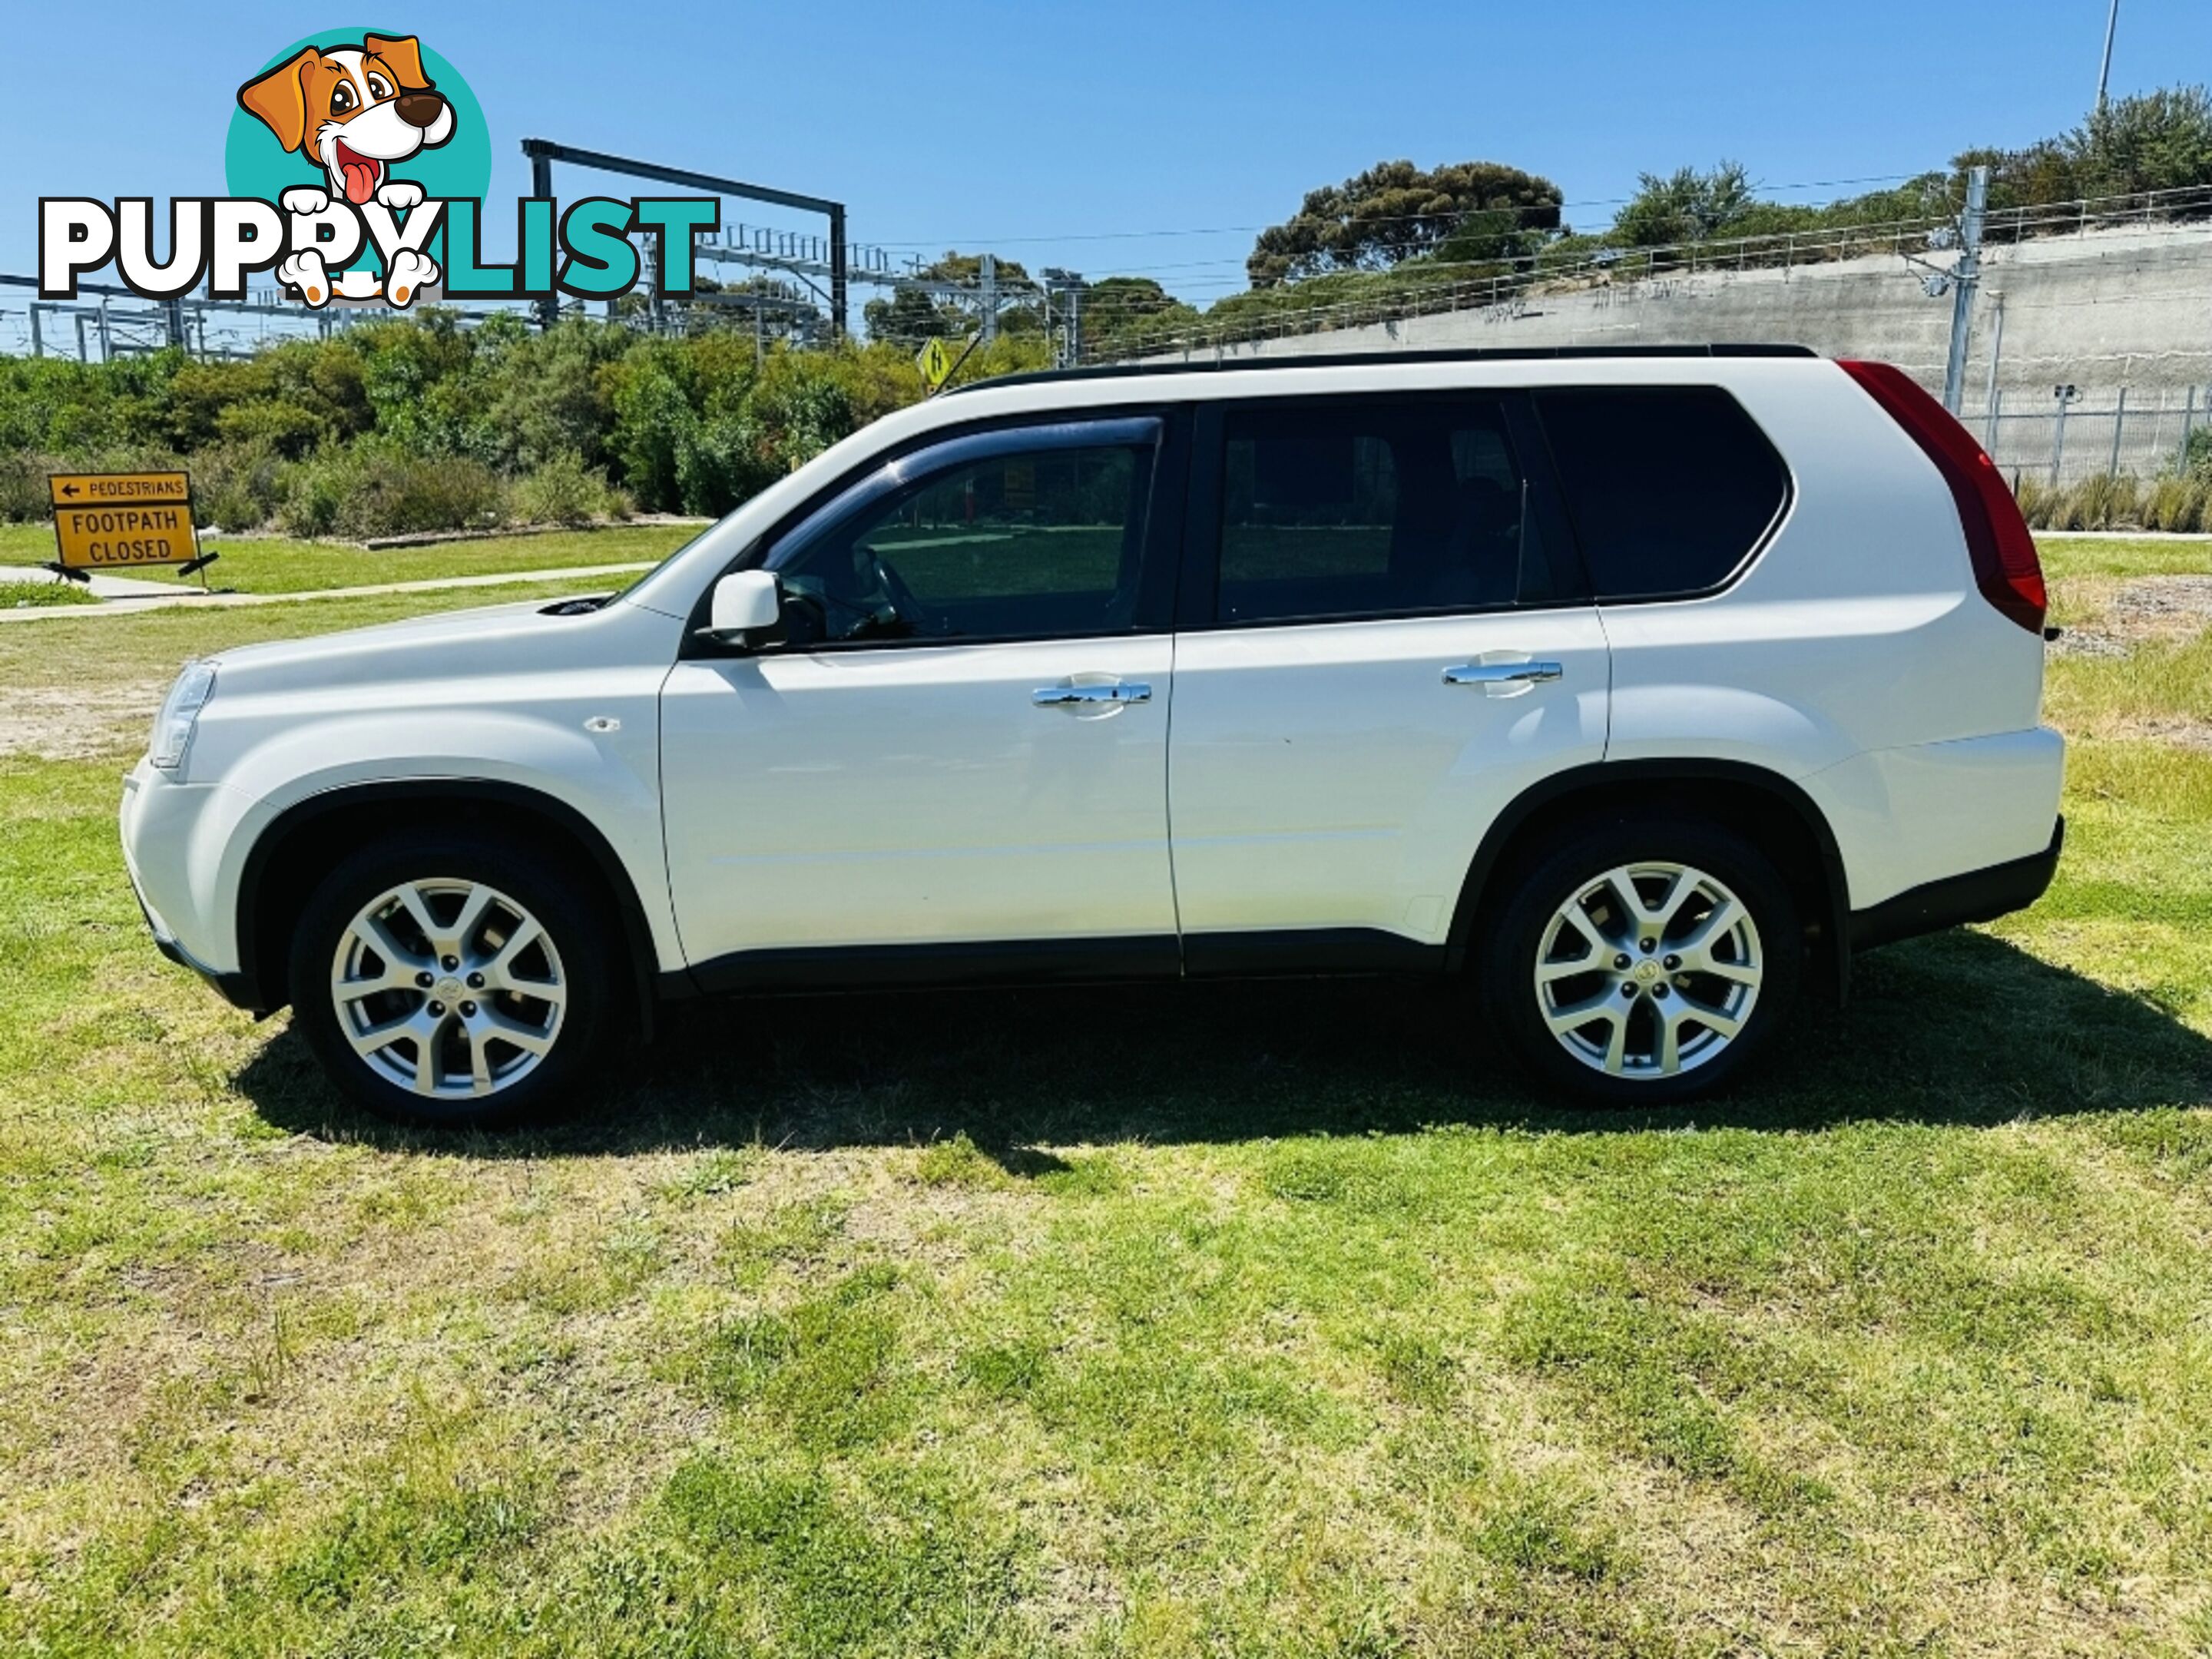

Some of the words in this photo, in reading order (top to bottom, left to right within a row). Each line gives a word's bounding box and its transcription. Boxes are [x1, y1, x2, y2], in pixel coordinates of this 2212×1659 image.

[90, 481, 184, 495] PEDESTRIANS
[72, 511, 178, 534] FOOTPATH
[89, 539, 171, 562] CLOSED
